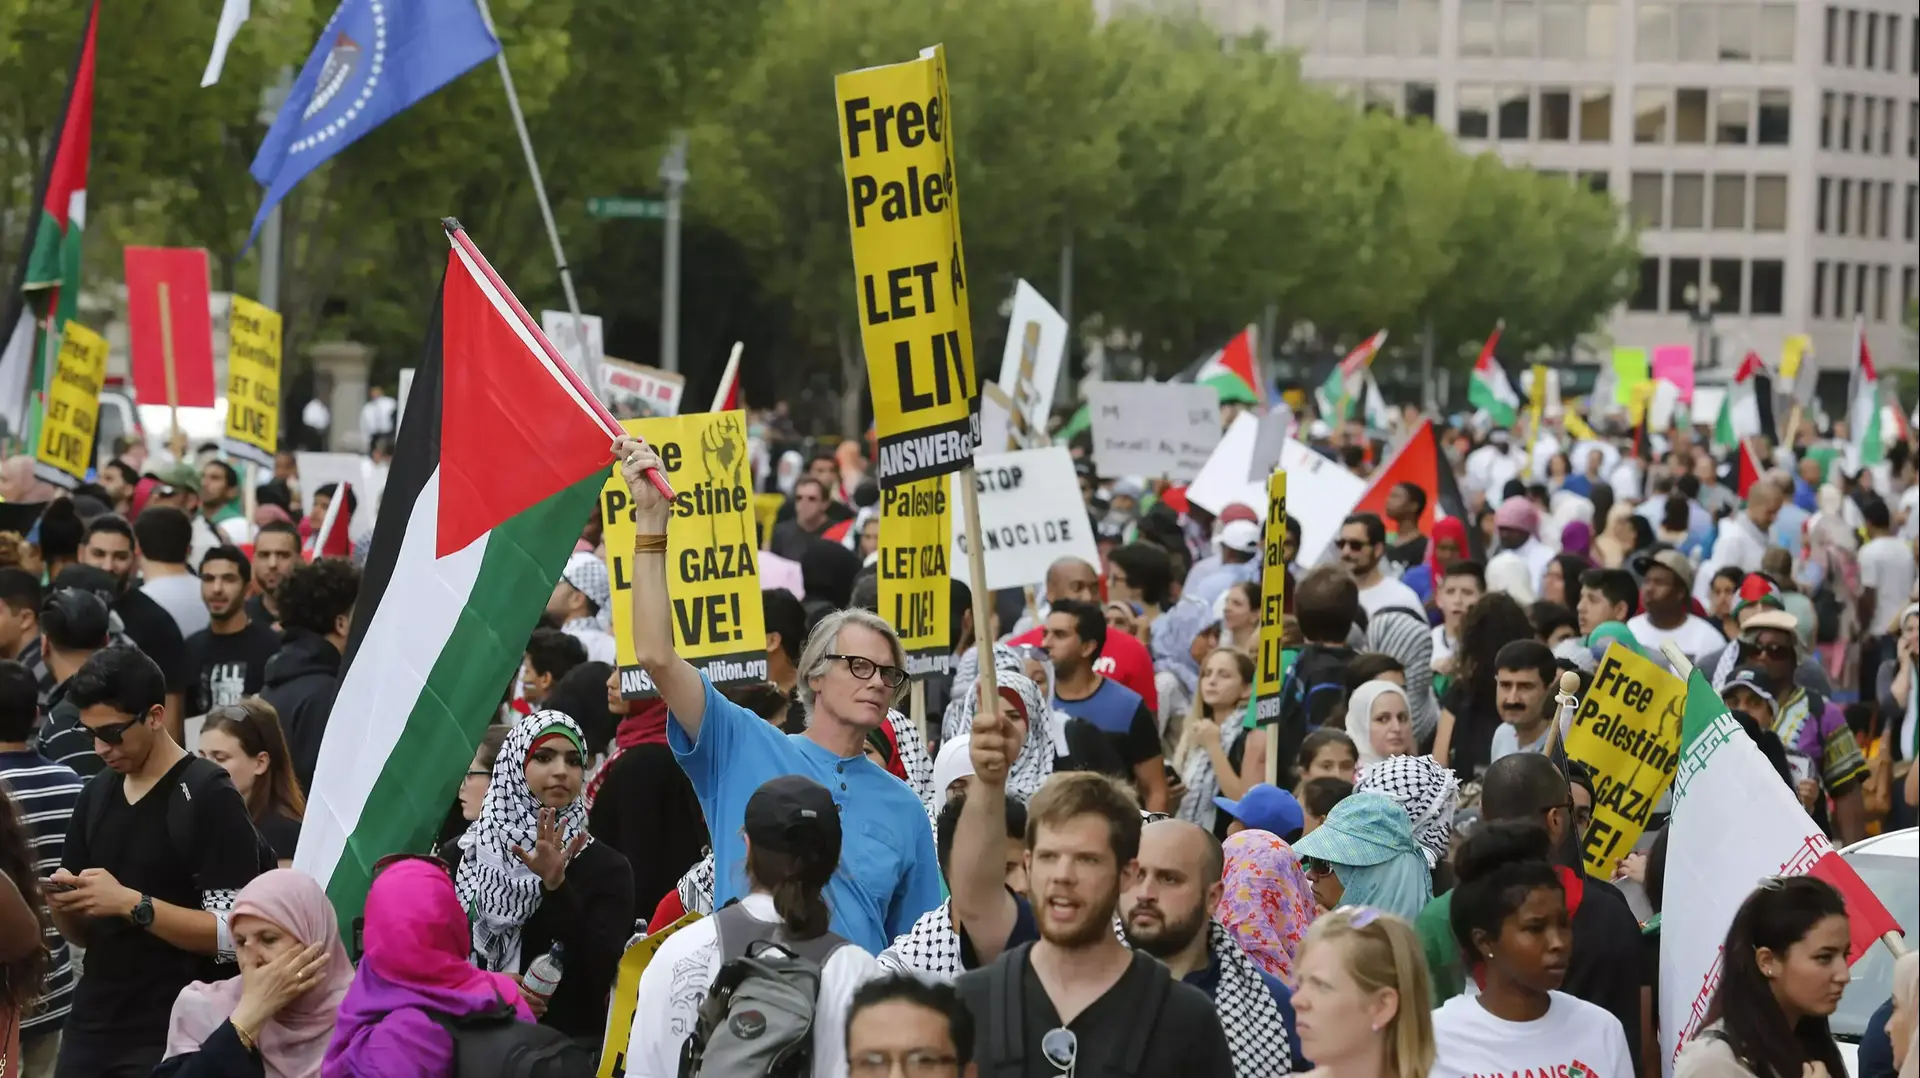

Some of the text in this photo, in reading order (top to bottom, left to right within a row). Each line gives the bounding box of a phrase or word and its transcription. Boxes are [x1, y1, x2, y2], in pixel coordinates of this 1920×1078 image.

[845, 96, 942, 158] Free
[864, 262, 938, 326] LET
[680, 543, 756, 583] GAZA
[882, 547, 916, 580] LET
[1595, 657, 1654, 713] Free
[1576, 698, 1680, 775] Palestine
[1596, 775, 1653, 827] GAZA
